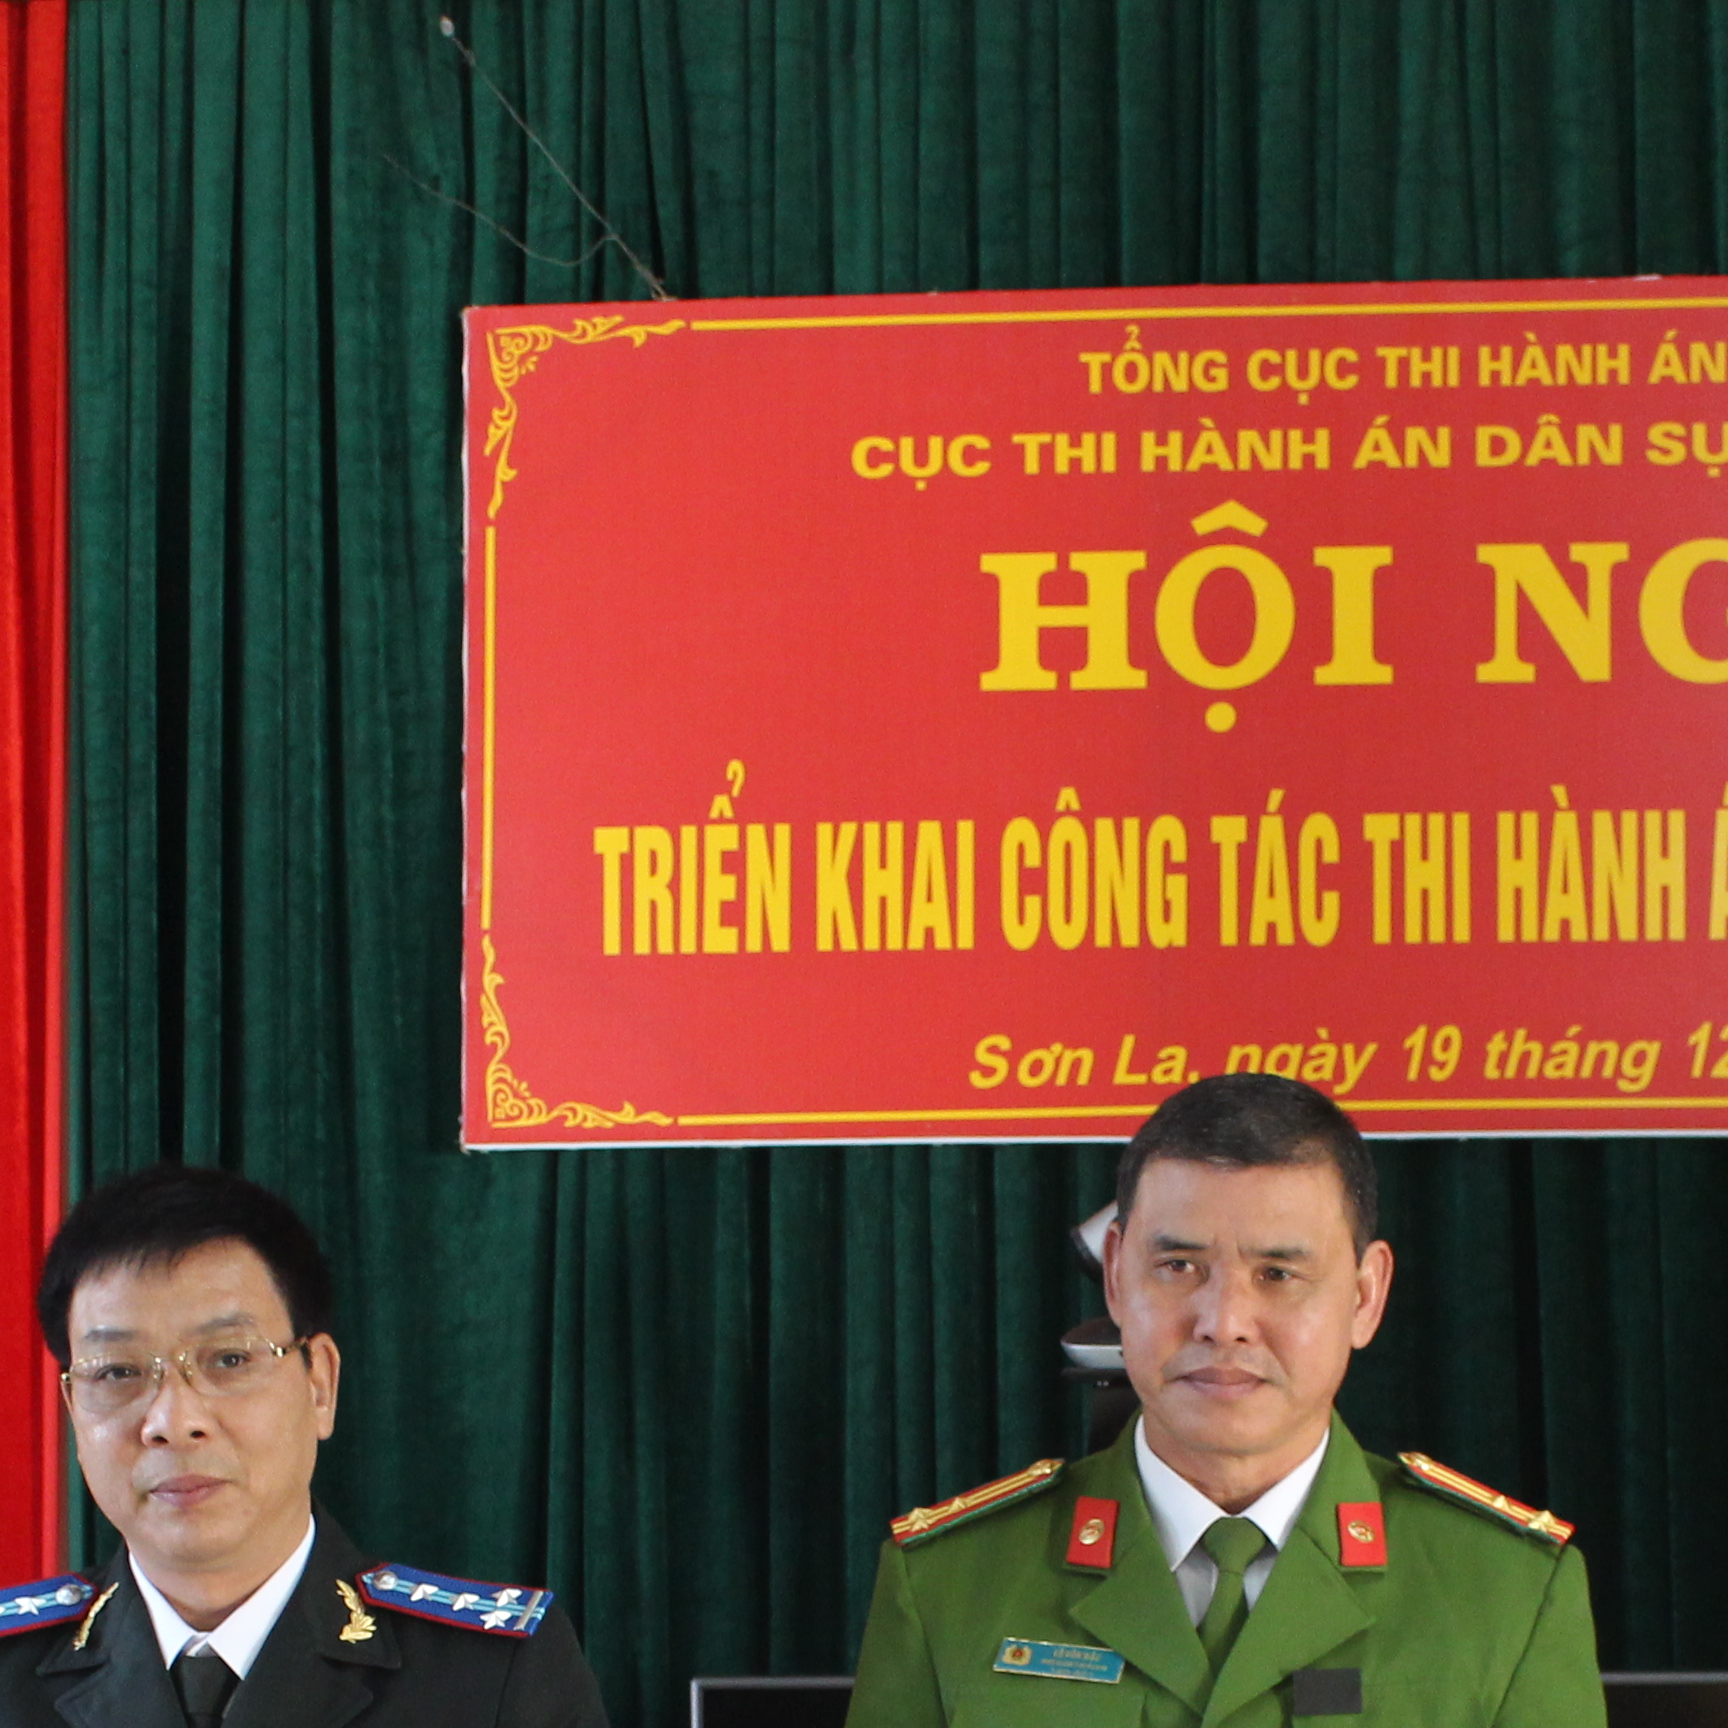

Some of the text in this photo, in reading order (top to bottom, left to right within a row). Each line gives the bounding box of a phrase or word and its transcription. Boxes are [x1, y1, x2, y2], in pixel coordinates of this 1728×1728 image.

[1078, 324, 1229, 395] TỔNG
[1246, 347, 1359, 406] CỤC
[1375, 345, 1460, 389] THI
[1478, 331, 1631, 387] HÀNH
[1648, 329, 1728, 385] ÁN
[851, 433, 992, 491] CỤC
[1011, 431, 1117, 475] THI
[1140, 417, 1331, 473] HÀNH
[1353, 415, 1451, 469] ÁN
[1475, 413, 1623, 468] DÂN
[979, 499, 1394, 733] HỘI
[592, 758, 792, 957] TRIỂN
[815, 819, 976, 953] KHAI
[1000, 786, 1188, 952] CÔNG
[1210, 788, 1340, 948] TÁC
[1363, 811, 1471, 945] THI
[1496, 784, 1687, 943] HÀNH
[968, 1034, 1095, 1090] Sơn
[1403, 1024, 1462, 1082] 19
[1484, 1025, 1662, 1093] tháng
